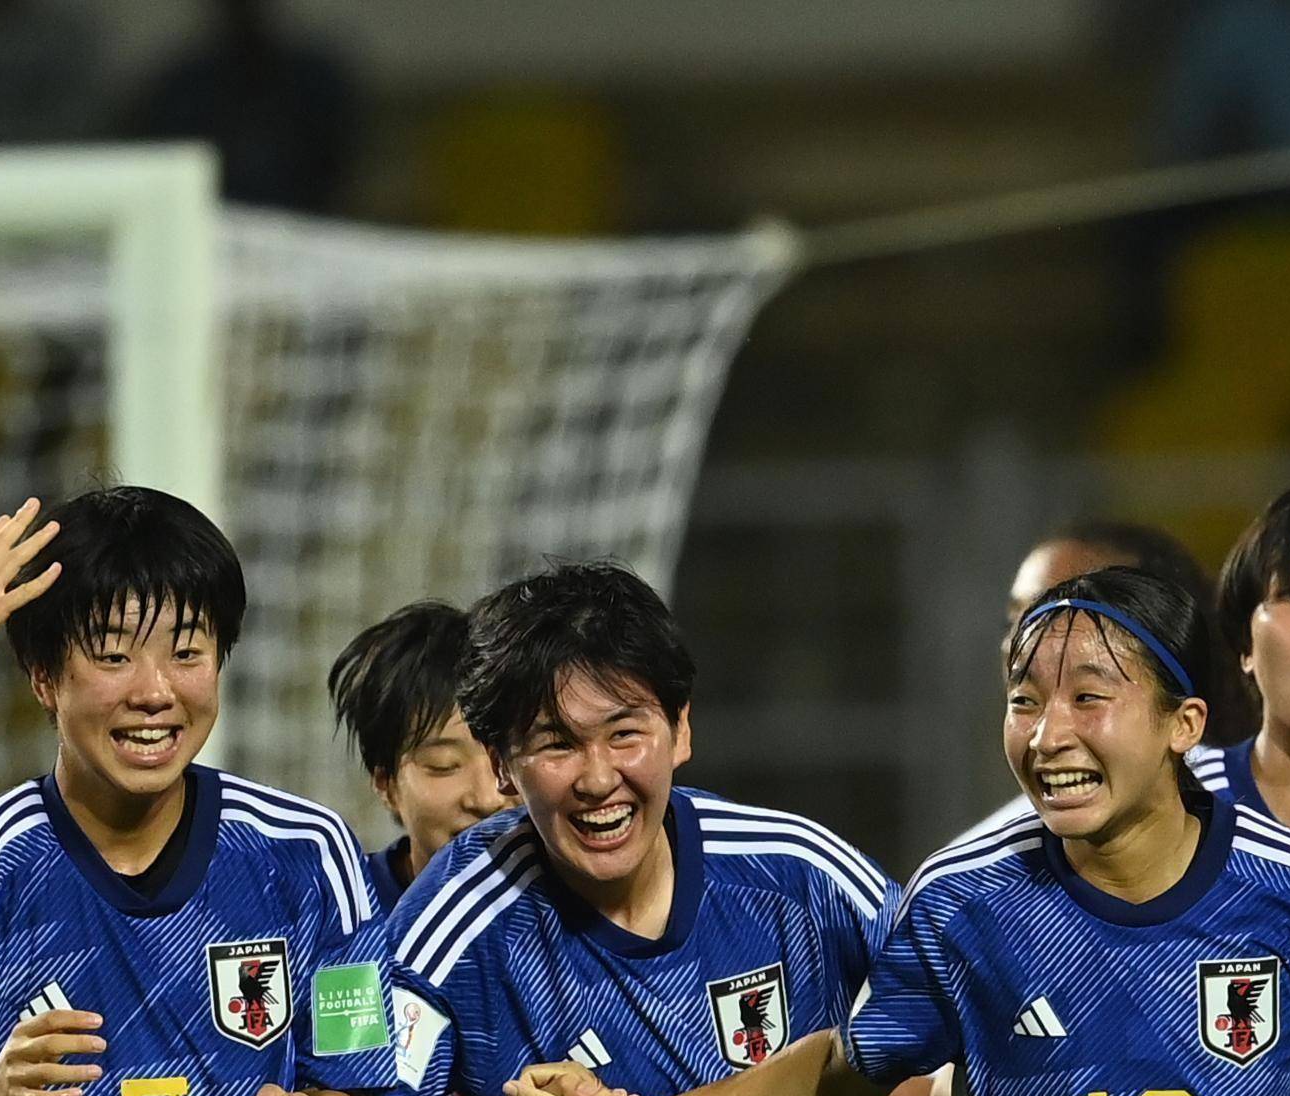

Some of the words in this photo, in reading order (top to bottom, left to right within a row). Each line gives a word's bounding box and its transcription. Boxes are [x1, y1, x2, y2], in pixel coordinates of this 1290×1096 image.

[228, 943, 271, 956] JAPAN
[1219, 963, 1261, 974] JAPAN
[728, 972, 767, 991] JAPAN
[318, 986, 375, 1001] LIVING
[318, 997, 377, 1011] FOOTBALL
[238, 1012, 274, 1030] JFA
[350, 1013, 379, 1028] FIFA
[1224, 1030, 1259, 1049] JFA
[743, 1037, 773, 1061] JFA
